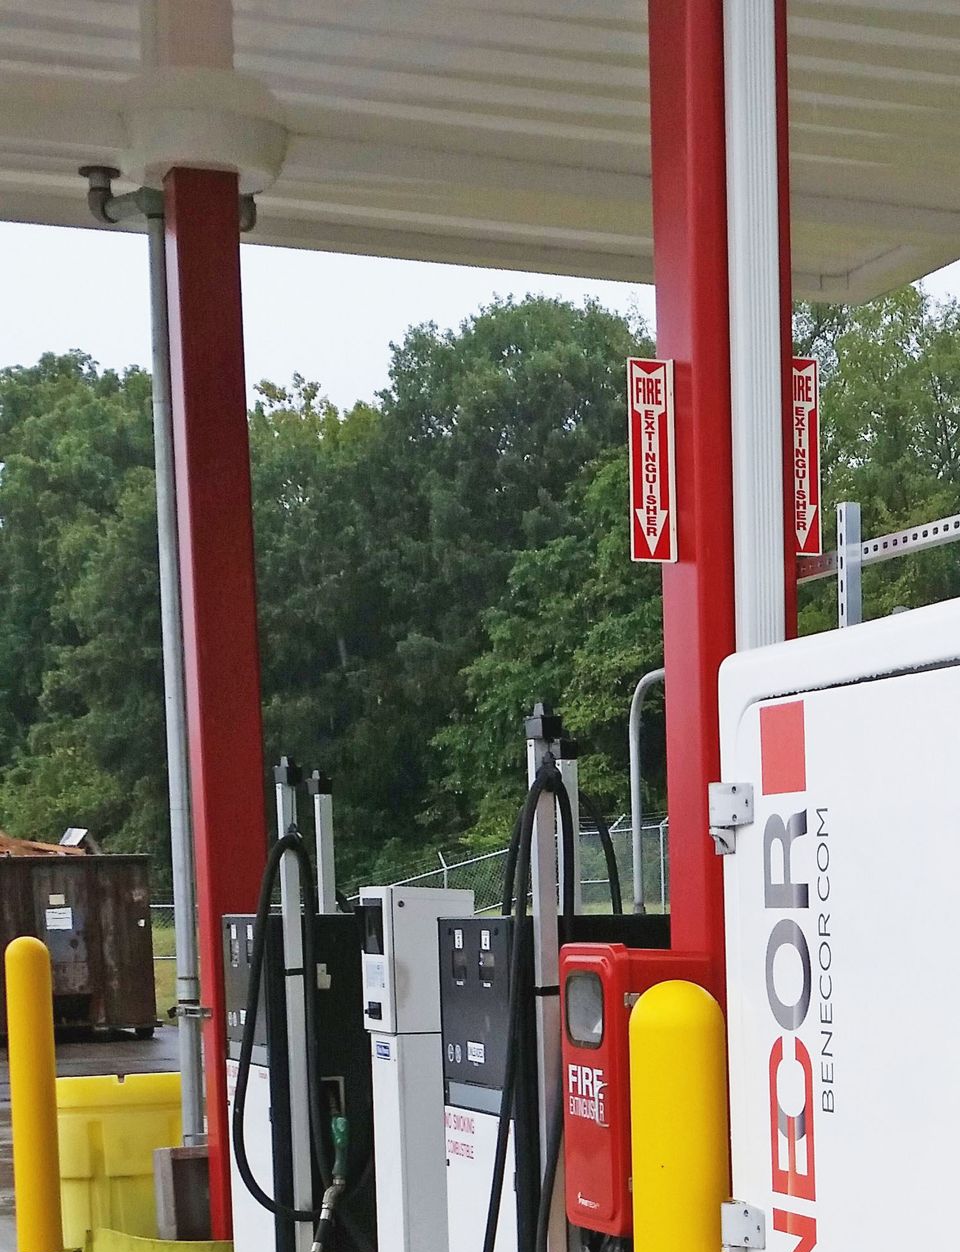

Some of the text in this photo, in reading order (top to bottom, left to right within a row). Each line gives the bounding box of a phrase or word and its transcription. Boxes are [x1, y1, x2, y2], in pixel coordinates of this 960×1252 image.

[635, 376, 662, 406] FIRE
[793, 374, 813, 403] IRE
[644, 409, 658, 537] EXTINGUISHER
[794, 406, 808, 532] EXTINGUISHER
[568, 1063, 604, 1100] FIRE
